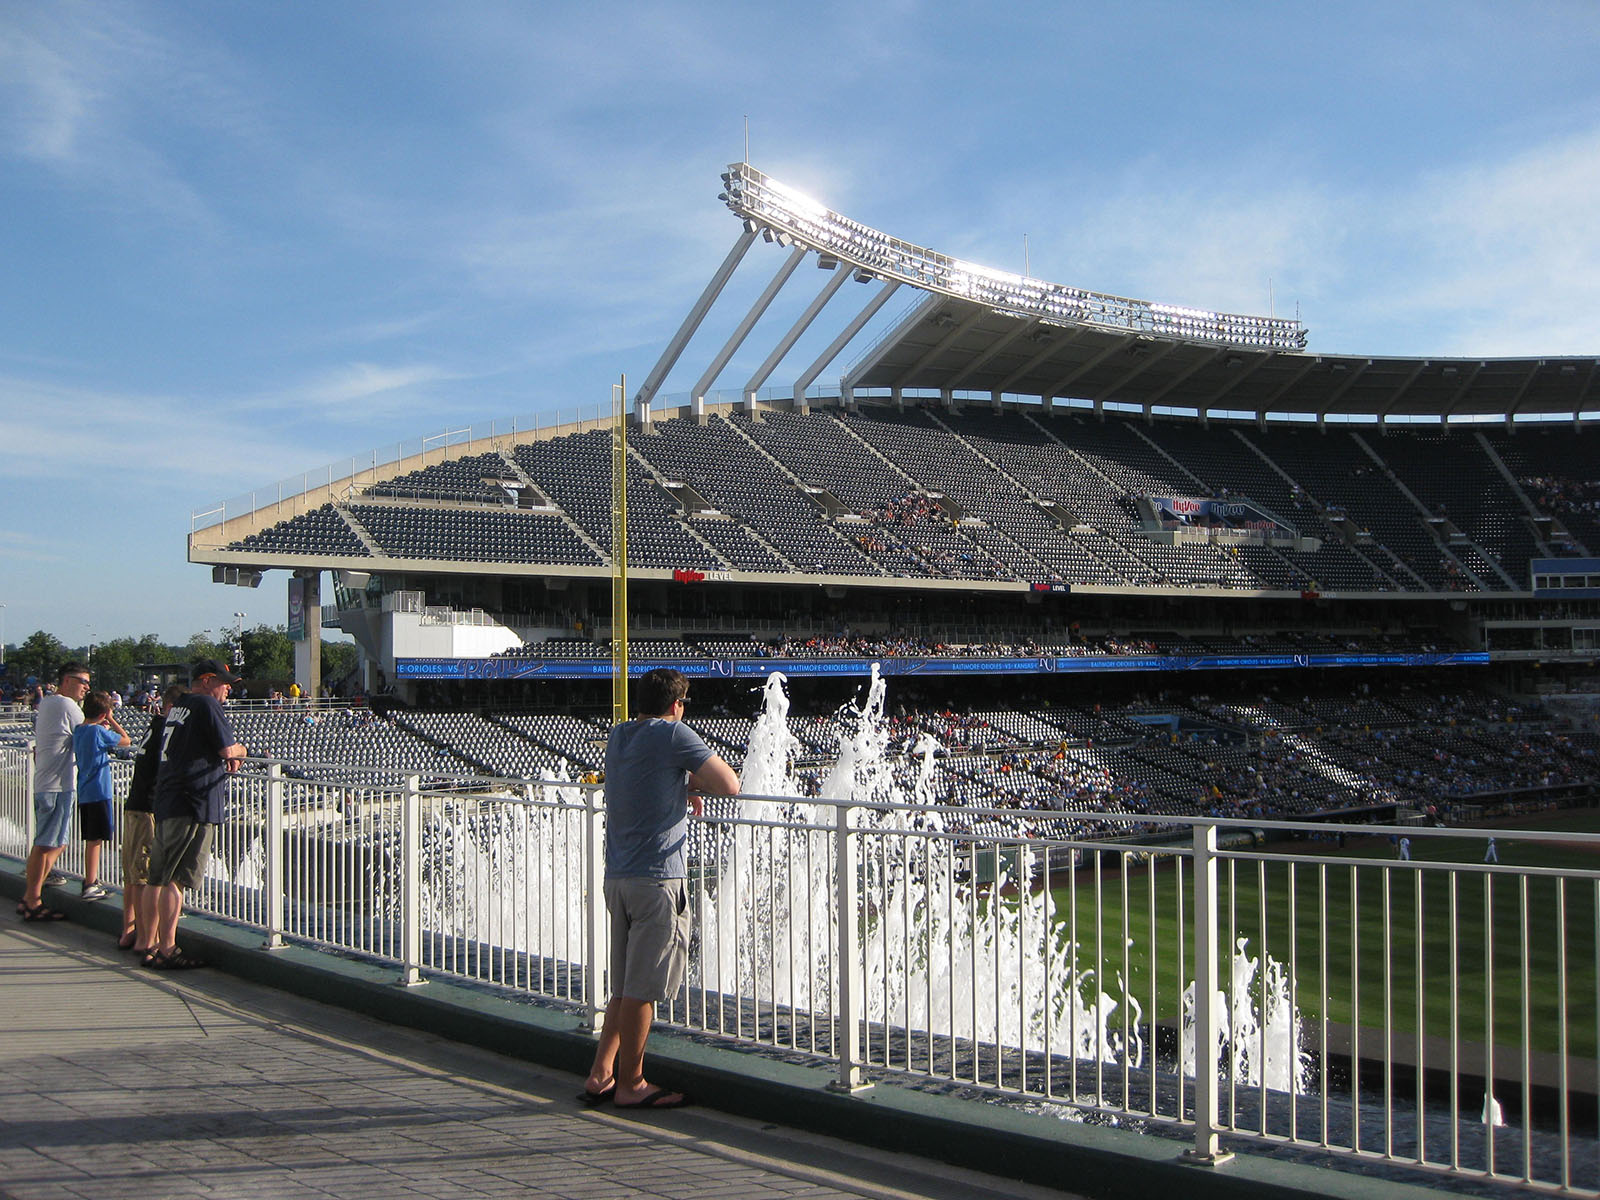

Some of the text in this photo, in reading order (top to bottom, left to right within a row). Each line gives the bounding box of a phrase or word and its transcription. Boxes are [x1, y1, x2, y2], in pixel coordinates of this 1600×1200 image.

[709, 572, 733, 581] LEVEL
[407, 664, 442, 673] ORIOLES
[681, 665, 709, 673] KANSAS
[788, 664, 822, 672] BALTIMORE
[823, 664, 848, 672] ORIOLES
